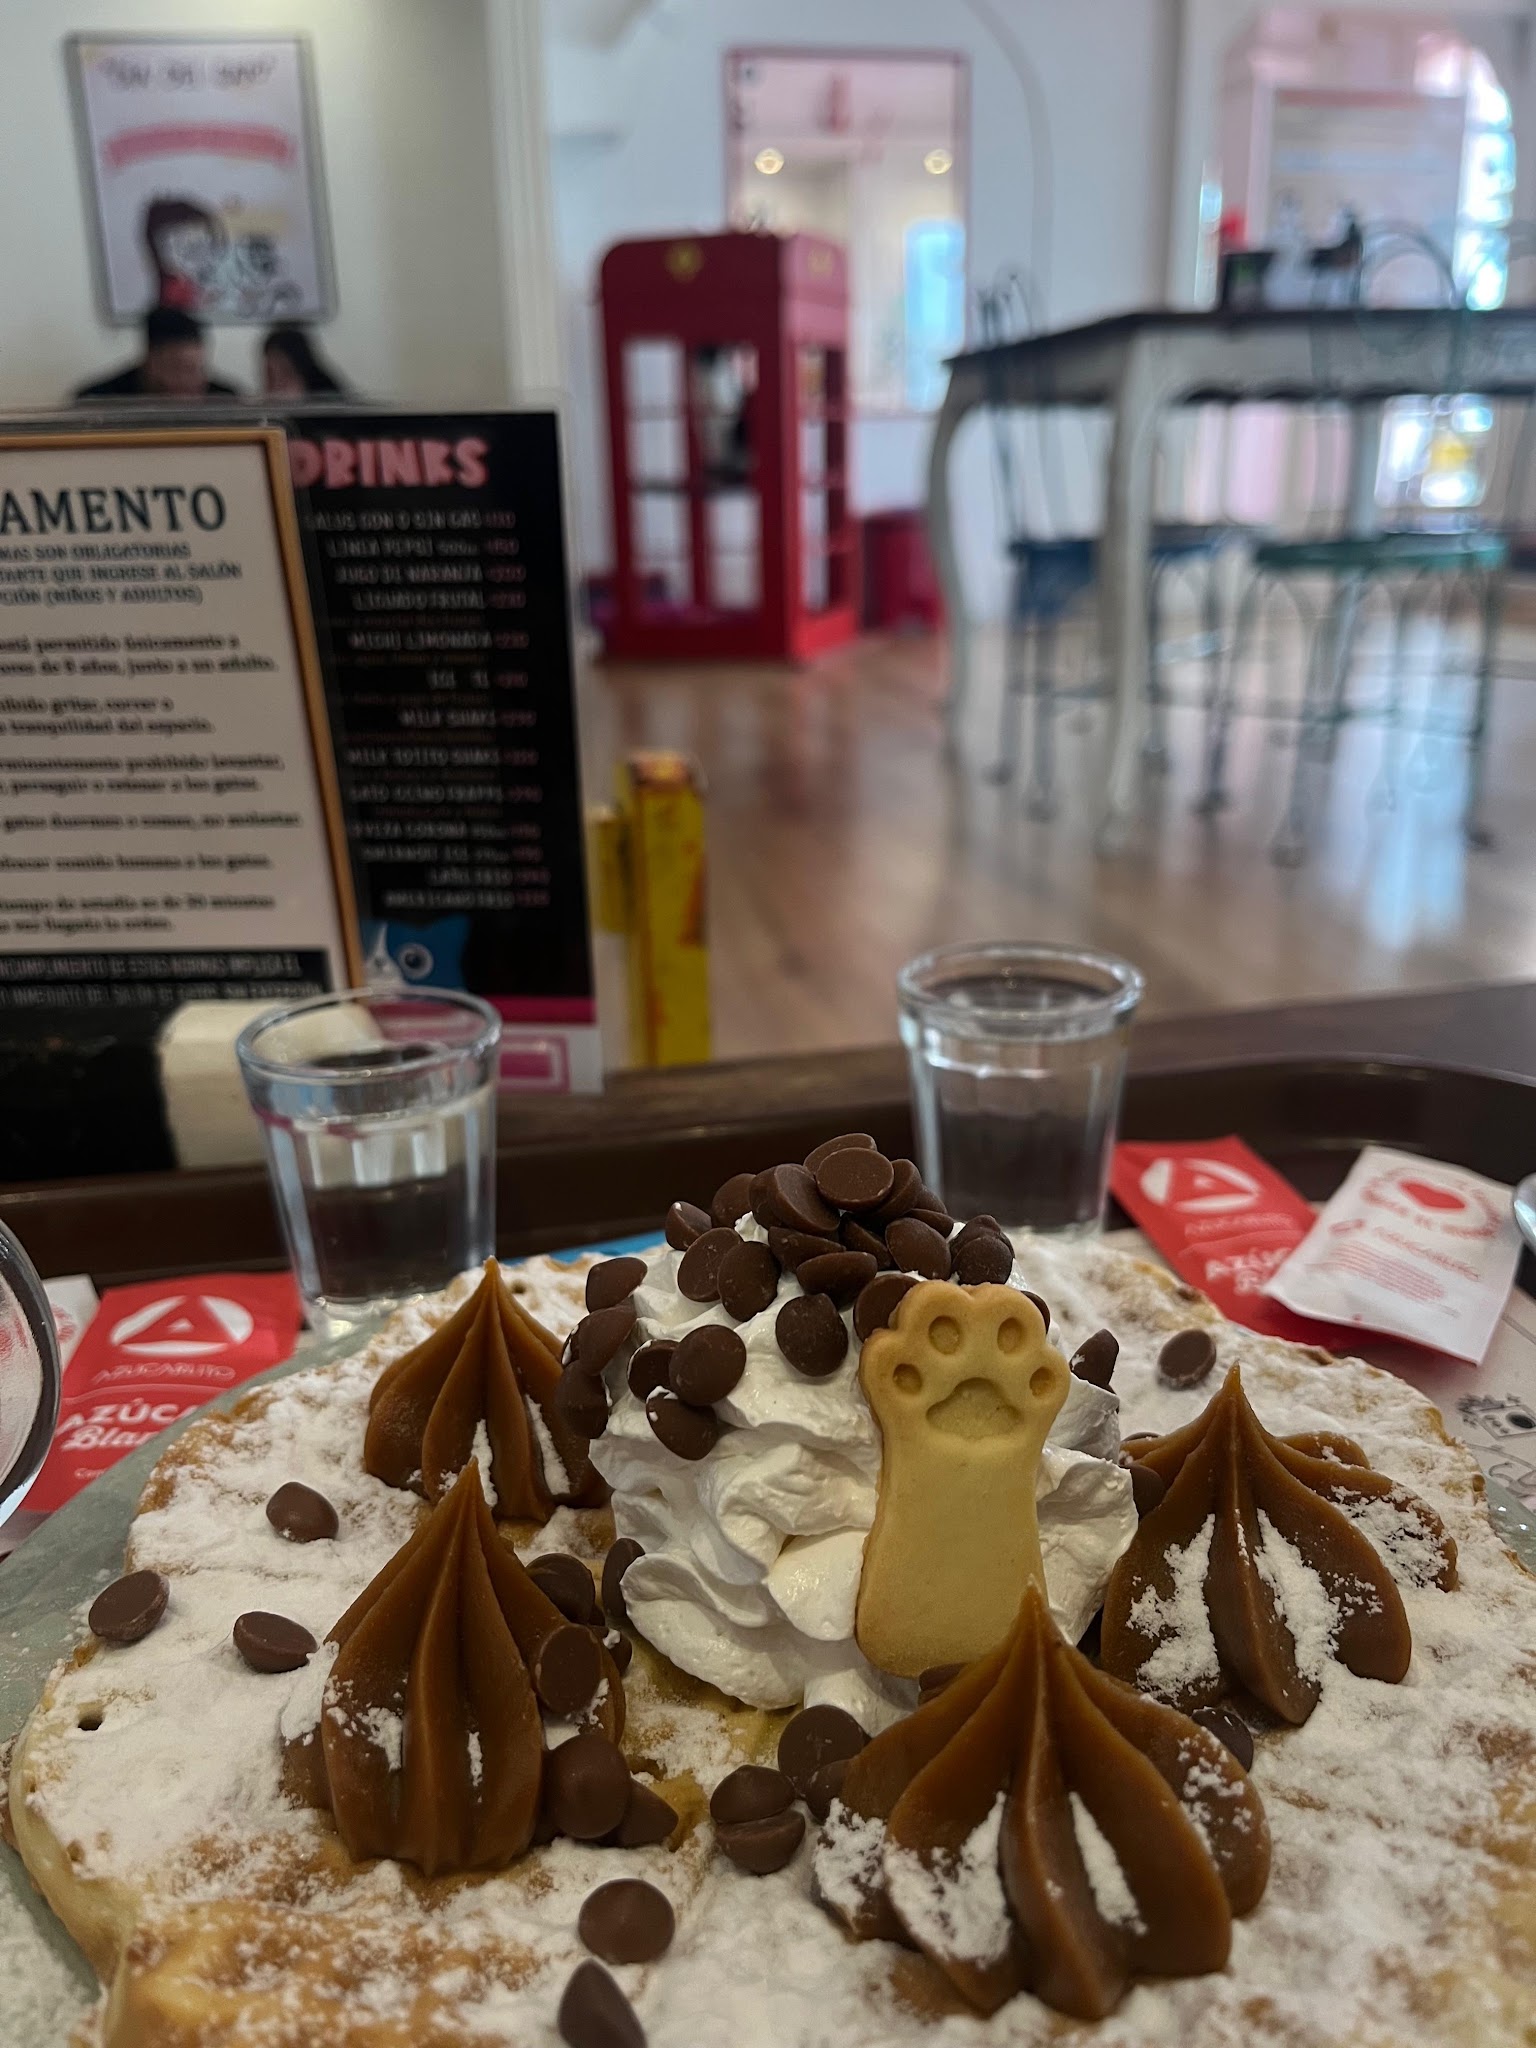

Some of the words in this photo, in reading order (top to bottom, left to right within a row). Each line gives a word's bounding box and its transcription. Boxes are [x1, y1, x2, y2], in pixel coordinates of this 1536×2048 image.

[289, 438, 490, 489] DRINKS
[0, 484, 227, 535] AMENTO
[35, 543, 67, 560] SON
[70, 541, 192, 560] OBLIGATORIAS
[187, 559, 243, 580] SALÓN
[35, 633, 120, 657] permitido
